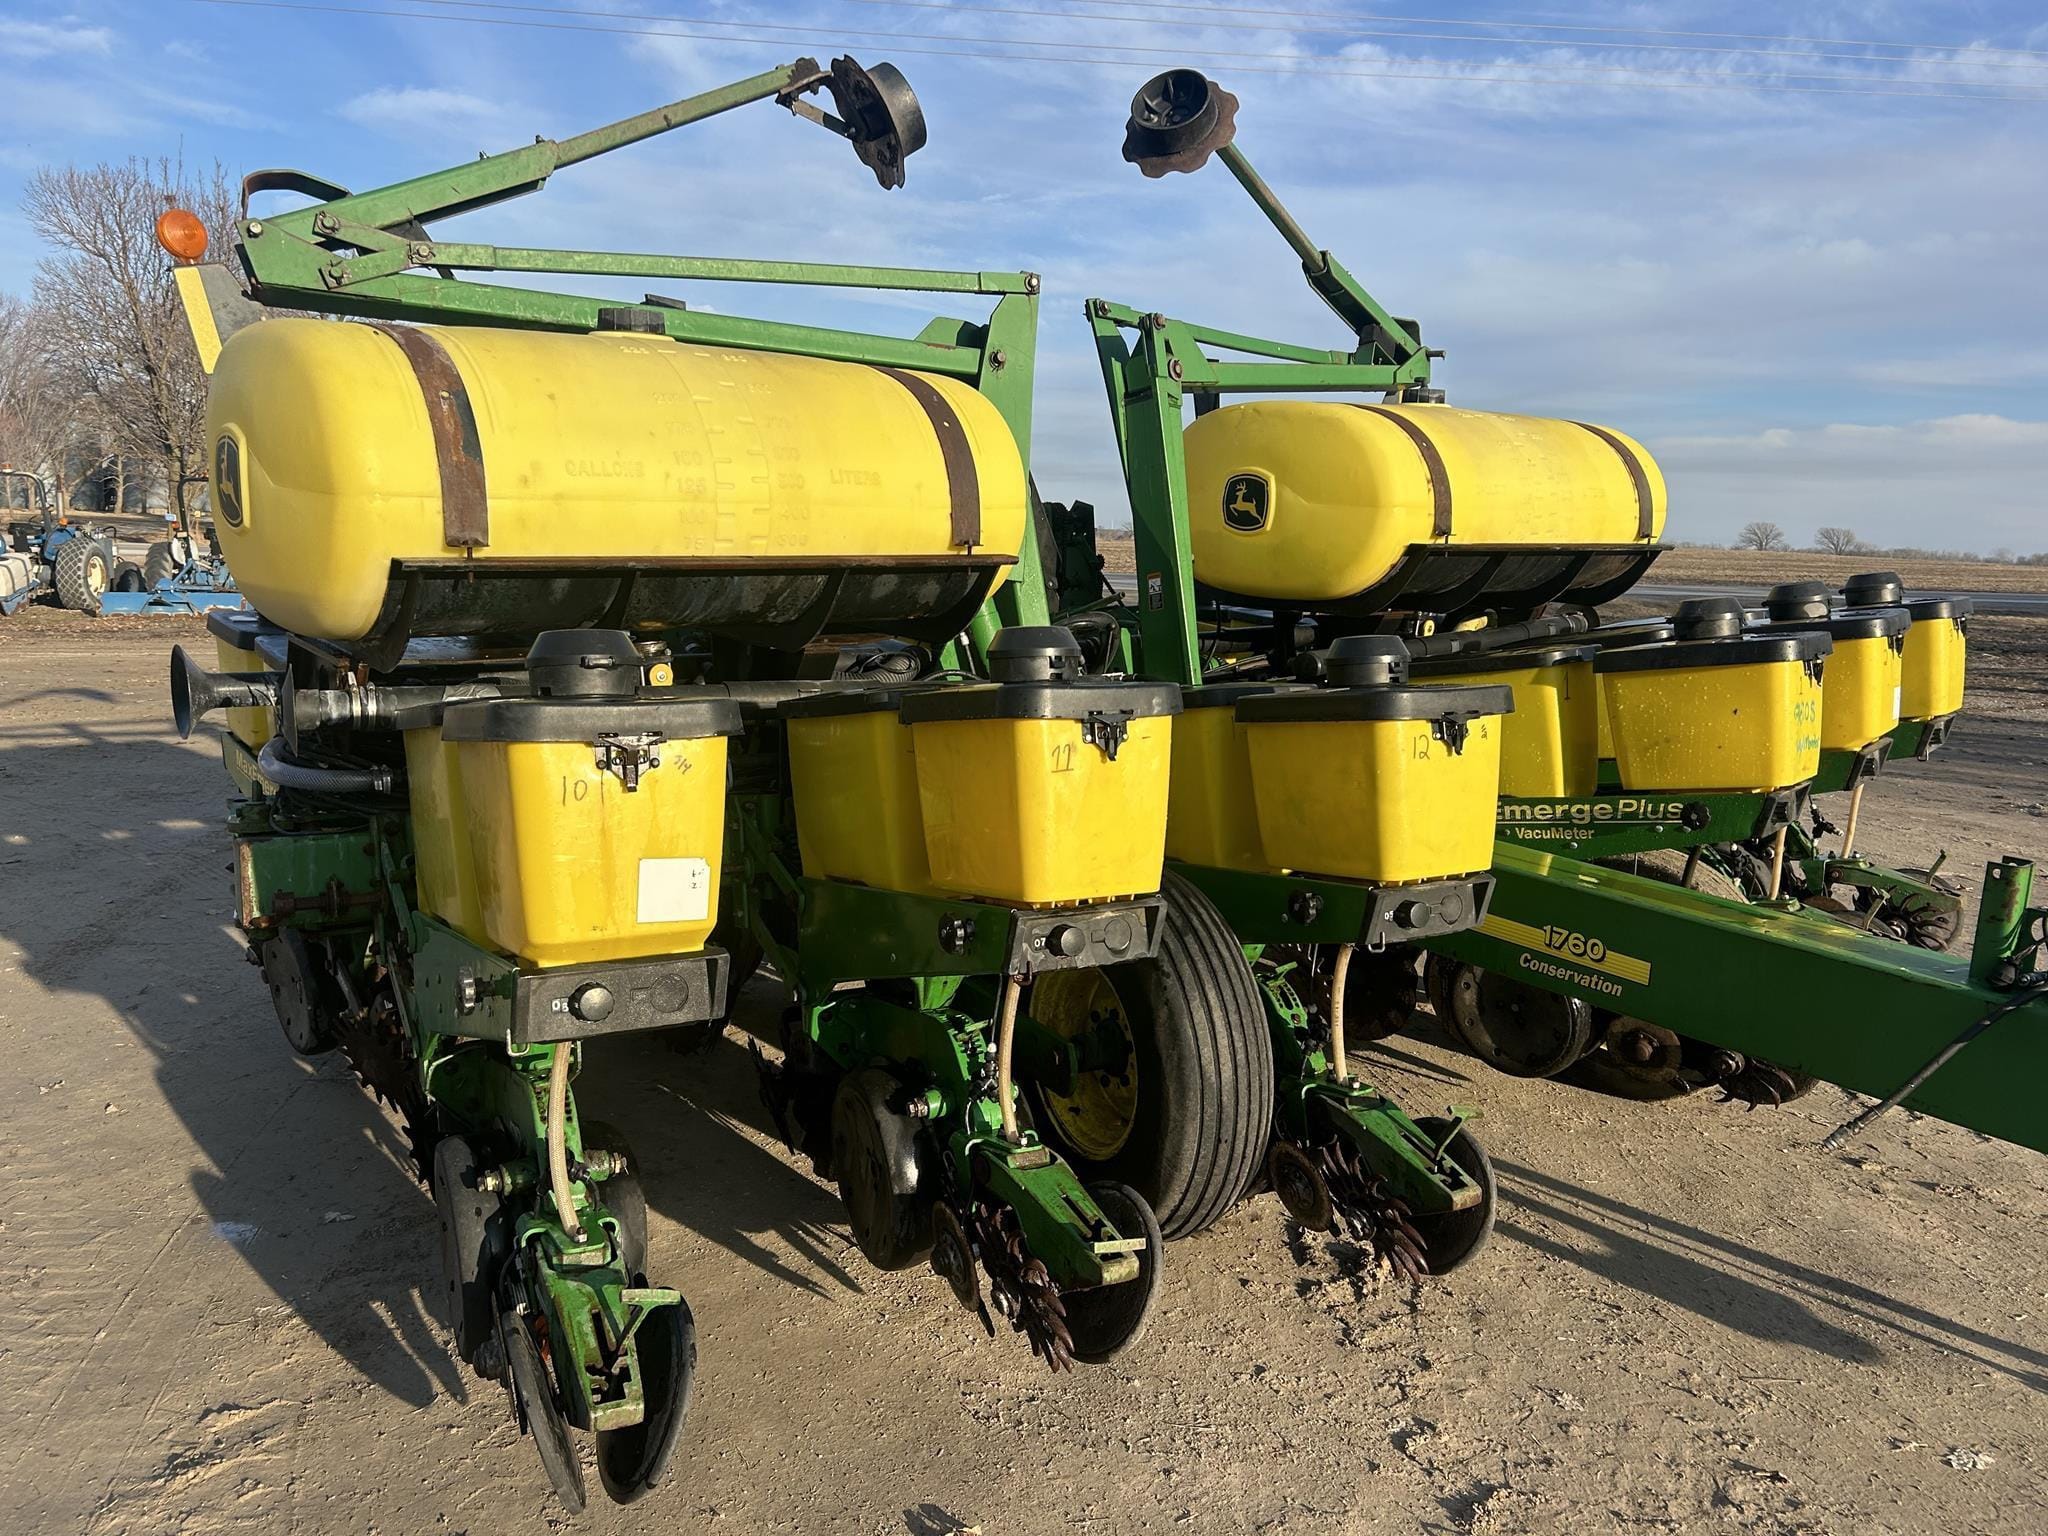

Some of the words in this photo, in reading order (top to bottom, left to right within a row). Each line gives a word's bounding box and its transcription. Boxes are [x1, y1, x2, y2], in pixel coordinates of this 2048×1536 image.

[1413, 734, 1430, 760] 12
[562, 775, 588, 807] 10
[1497, 799, 1684, 824] mergePlus
[1515, 827, 1595, 840] VacuMeter
[1543, 924, 1606, 962] 1760
[1519, 952, 1624, 997] Conservation
